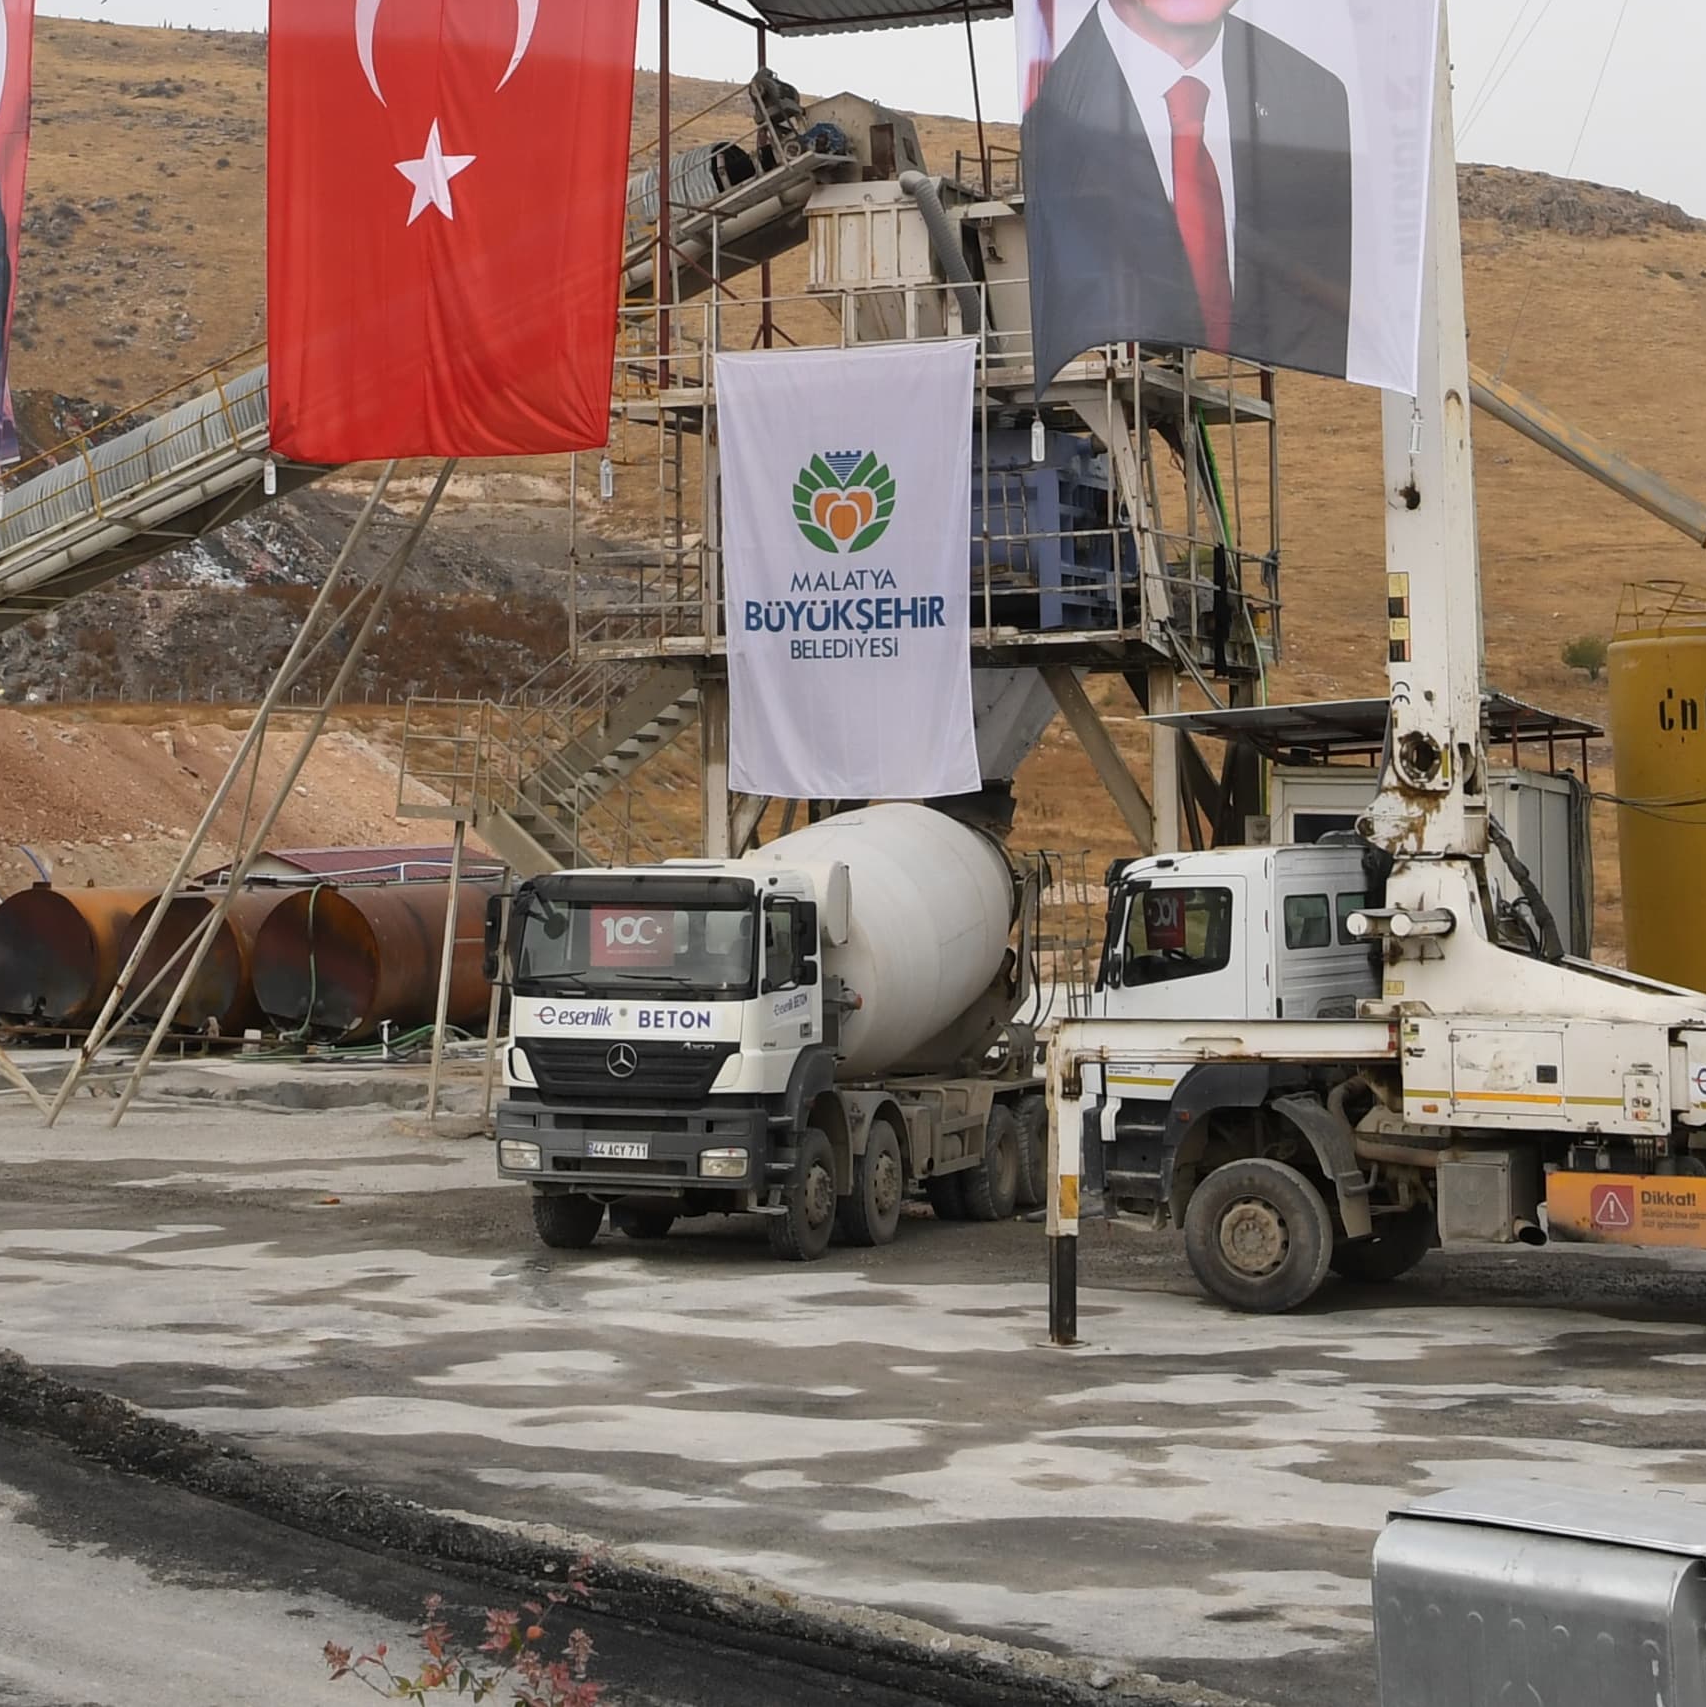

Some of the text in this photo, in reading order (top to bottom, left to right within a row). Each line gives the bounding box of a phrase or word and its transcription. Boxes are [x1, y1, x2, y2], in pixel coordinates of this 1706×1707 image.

[790, 568, 897, 592] MALATYA
[744, 595, 946, 635] BÜYÜKŞEHİR
[790, 636, 899, 660] BELEDİYESİ
[559, 1006, 613, 1026] esenlik
[638, 1010, 711, 1029] BETON
[1641, 1190, 1697, 1206] Dikkat!
